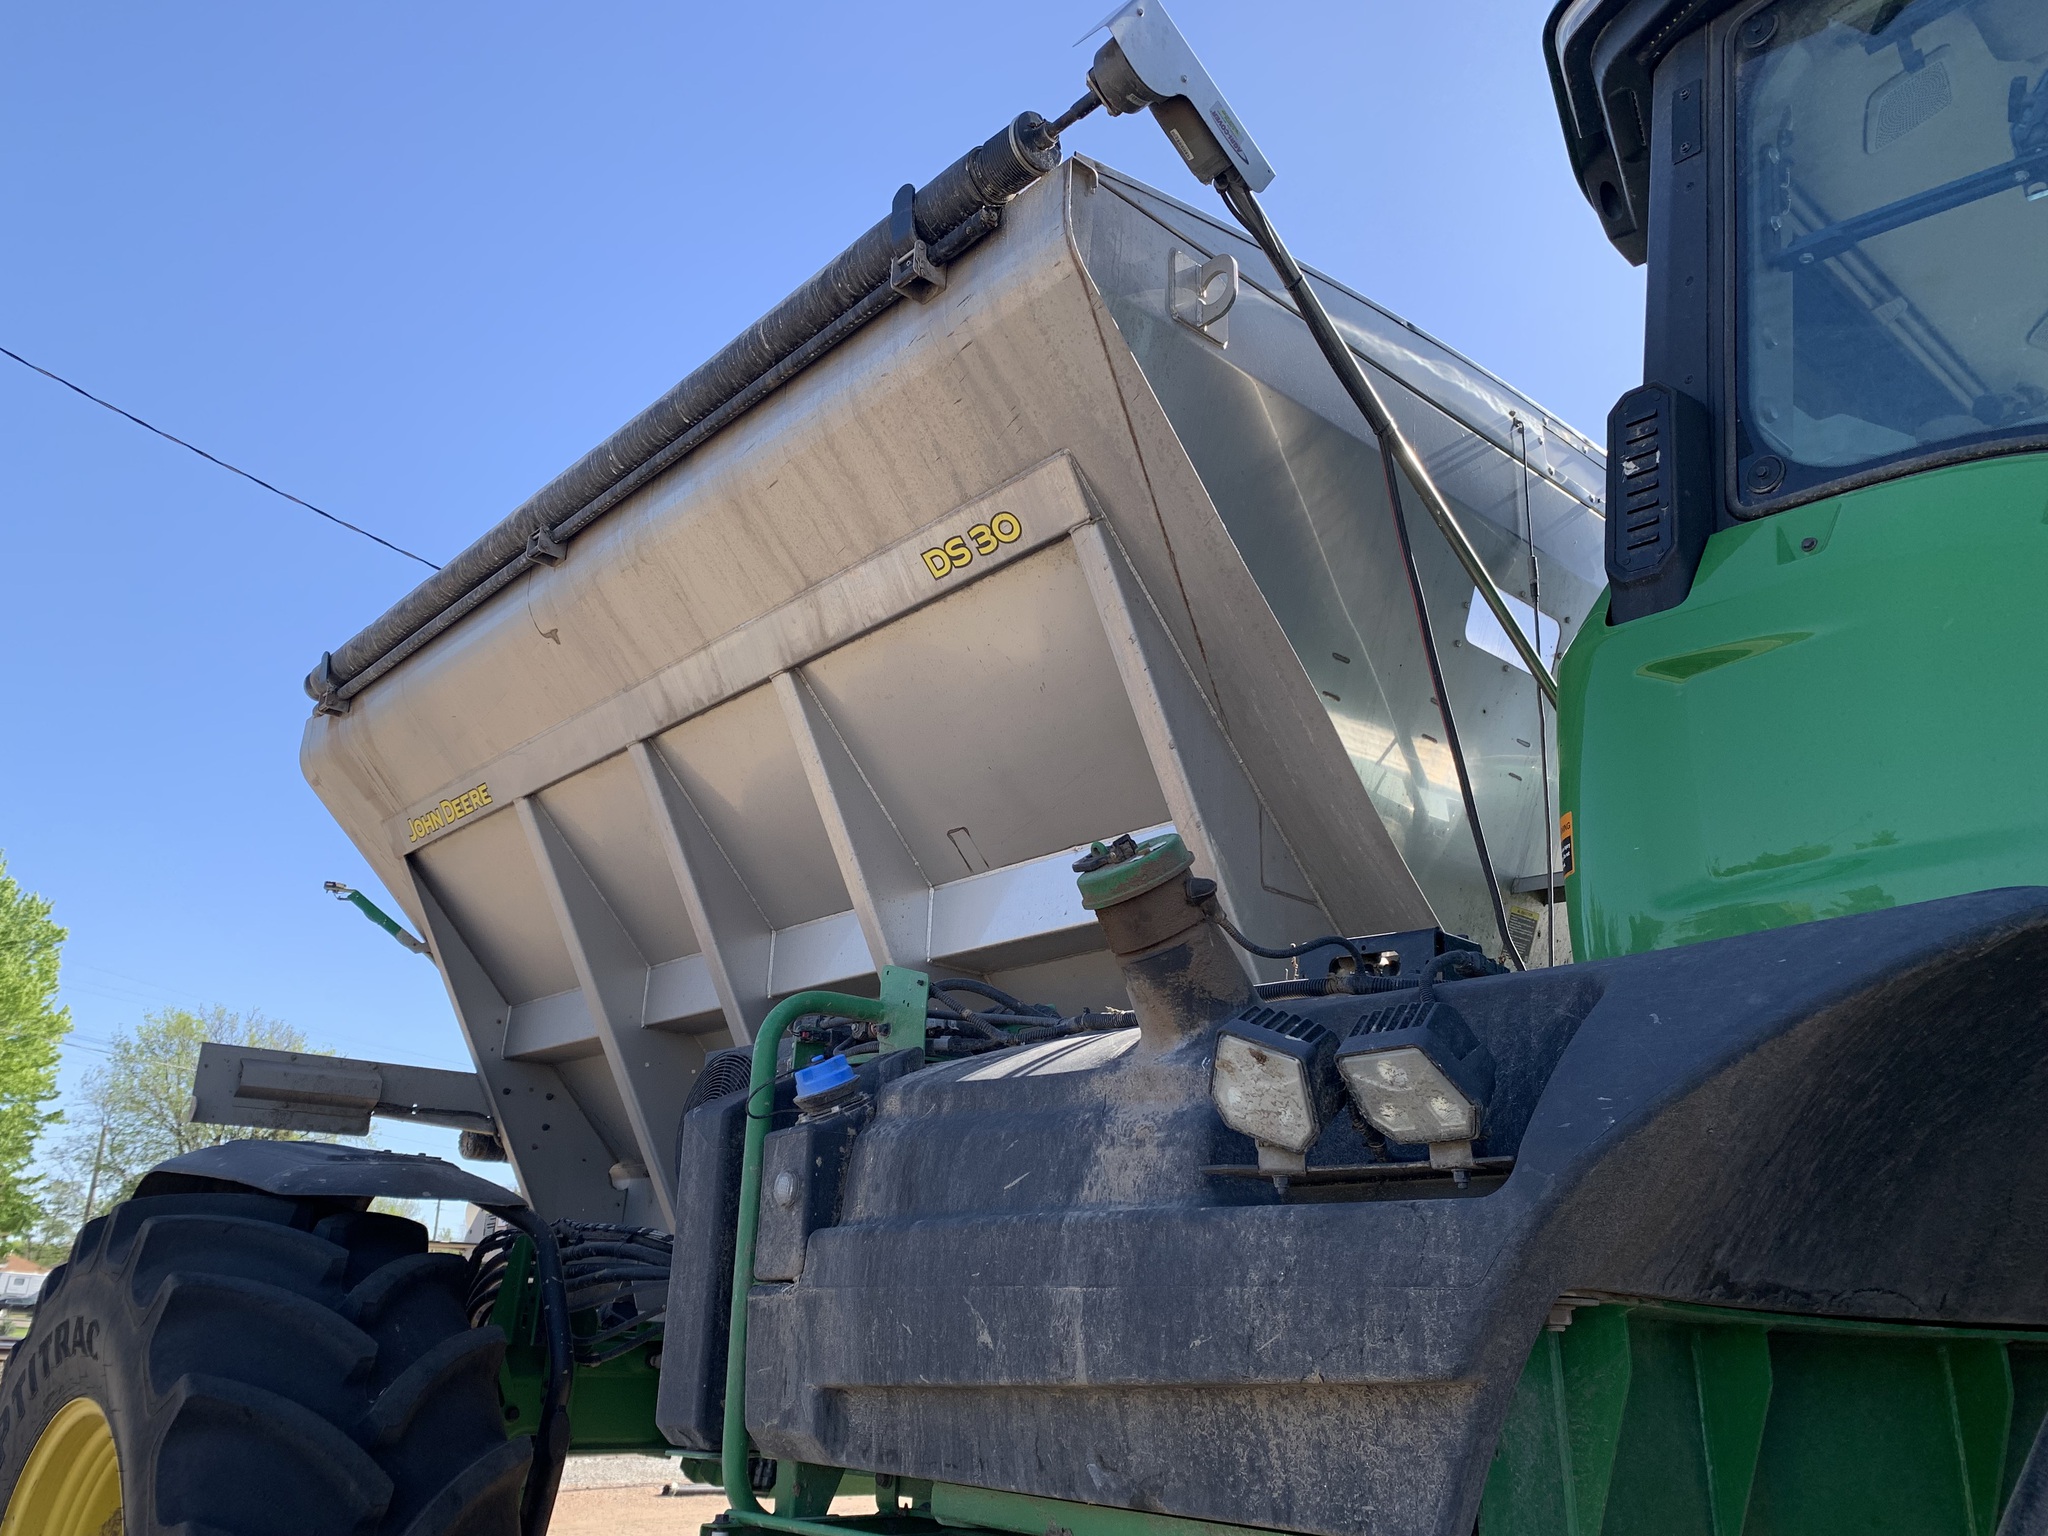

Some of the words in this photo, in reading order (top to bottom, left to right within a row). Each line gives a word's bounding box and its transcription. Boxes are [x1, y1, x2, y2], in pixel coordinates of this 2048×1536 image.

[1211, 110, 1243, 153] AGRI-COVER
[920, 535, 973, 581] DS
[967, 511, 1022, 556] 30
[407, 807, 445, 843] JOHN
[439, 782, 493, 825] DEERE
